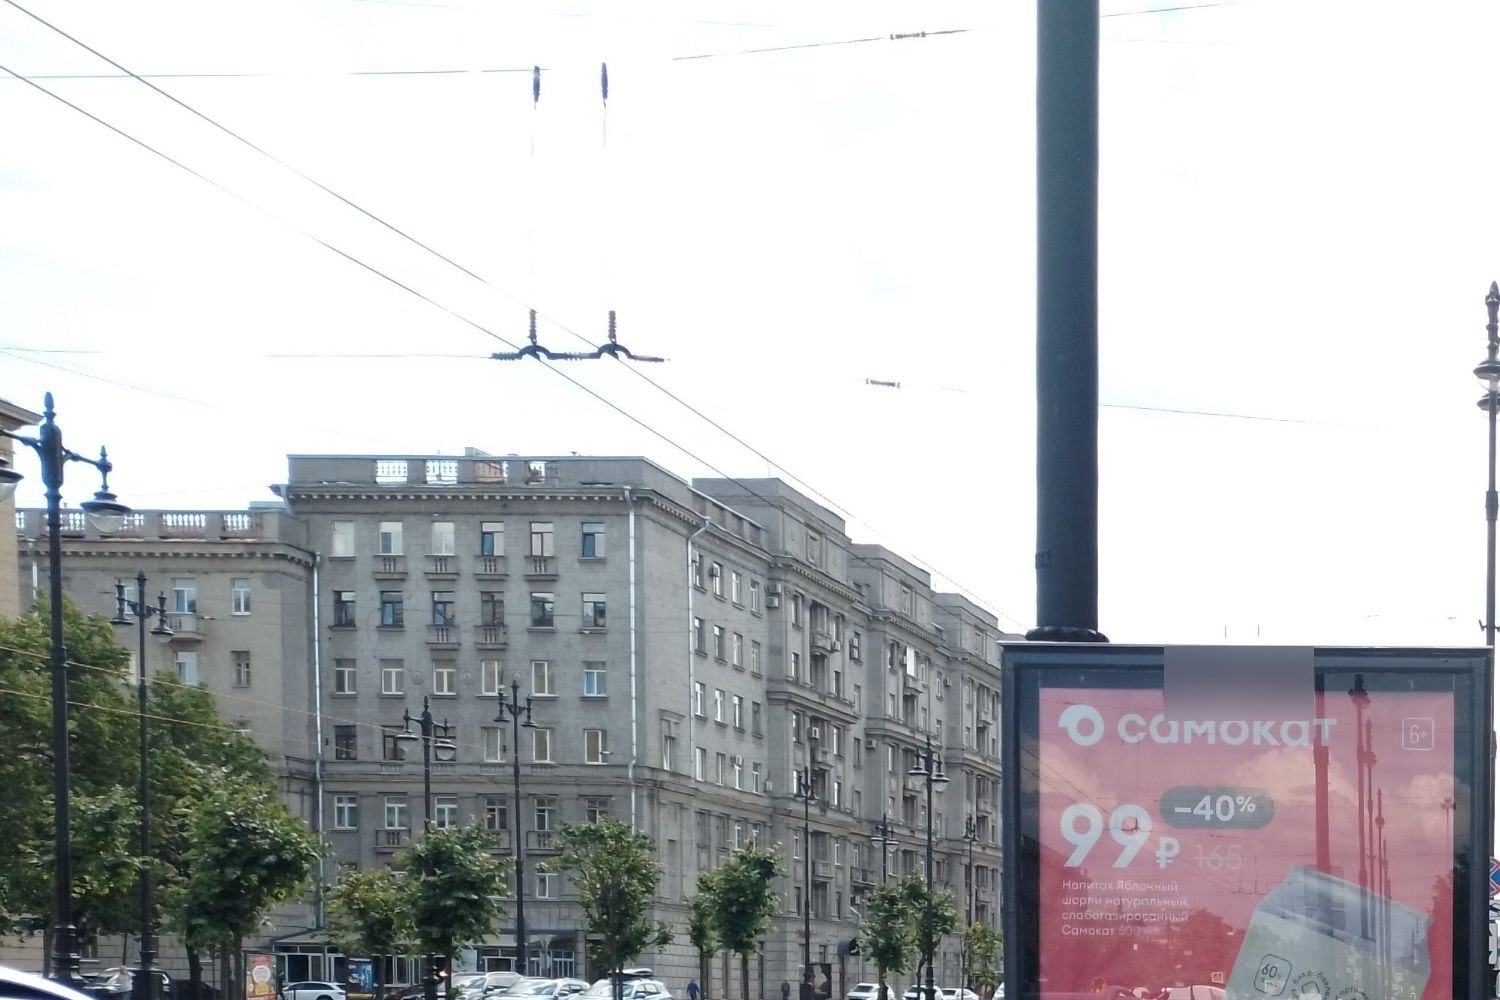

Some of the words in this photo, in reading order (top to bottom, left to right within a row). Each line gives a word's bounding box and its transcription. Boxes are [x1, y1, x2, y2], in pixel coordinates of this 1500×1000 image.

[1117, 712, 1338, 747] самокат
[1410, 724, 1428, 744] 6+
[1061, 879, 1114, 890] Напиток
[1116, 879, 1178, 891] Яблочный
[1061, 896, 1102, 907] шорли
[1061, 924, 1116, 936] Самокат
